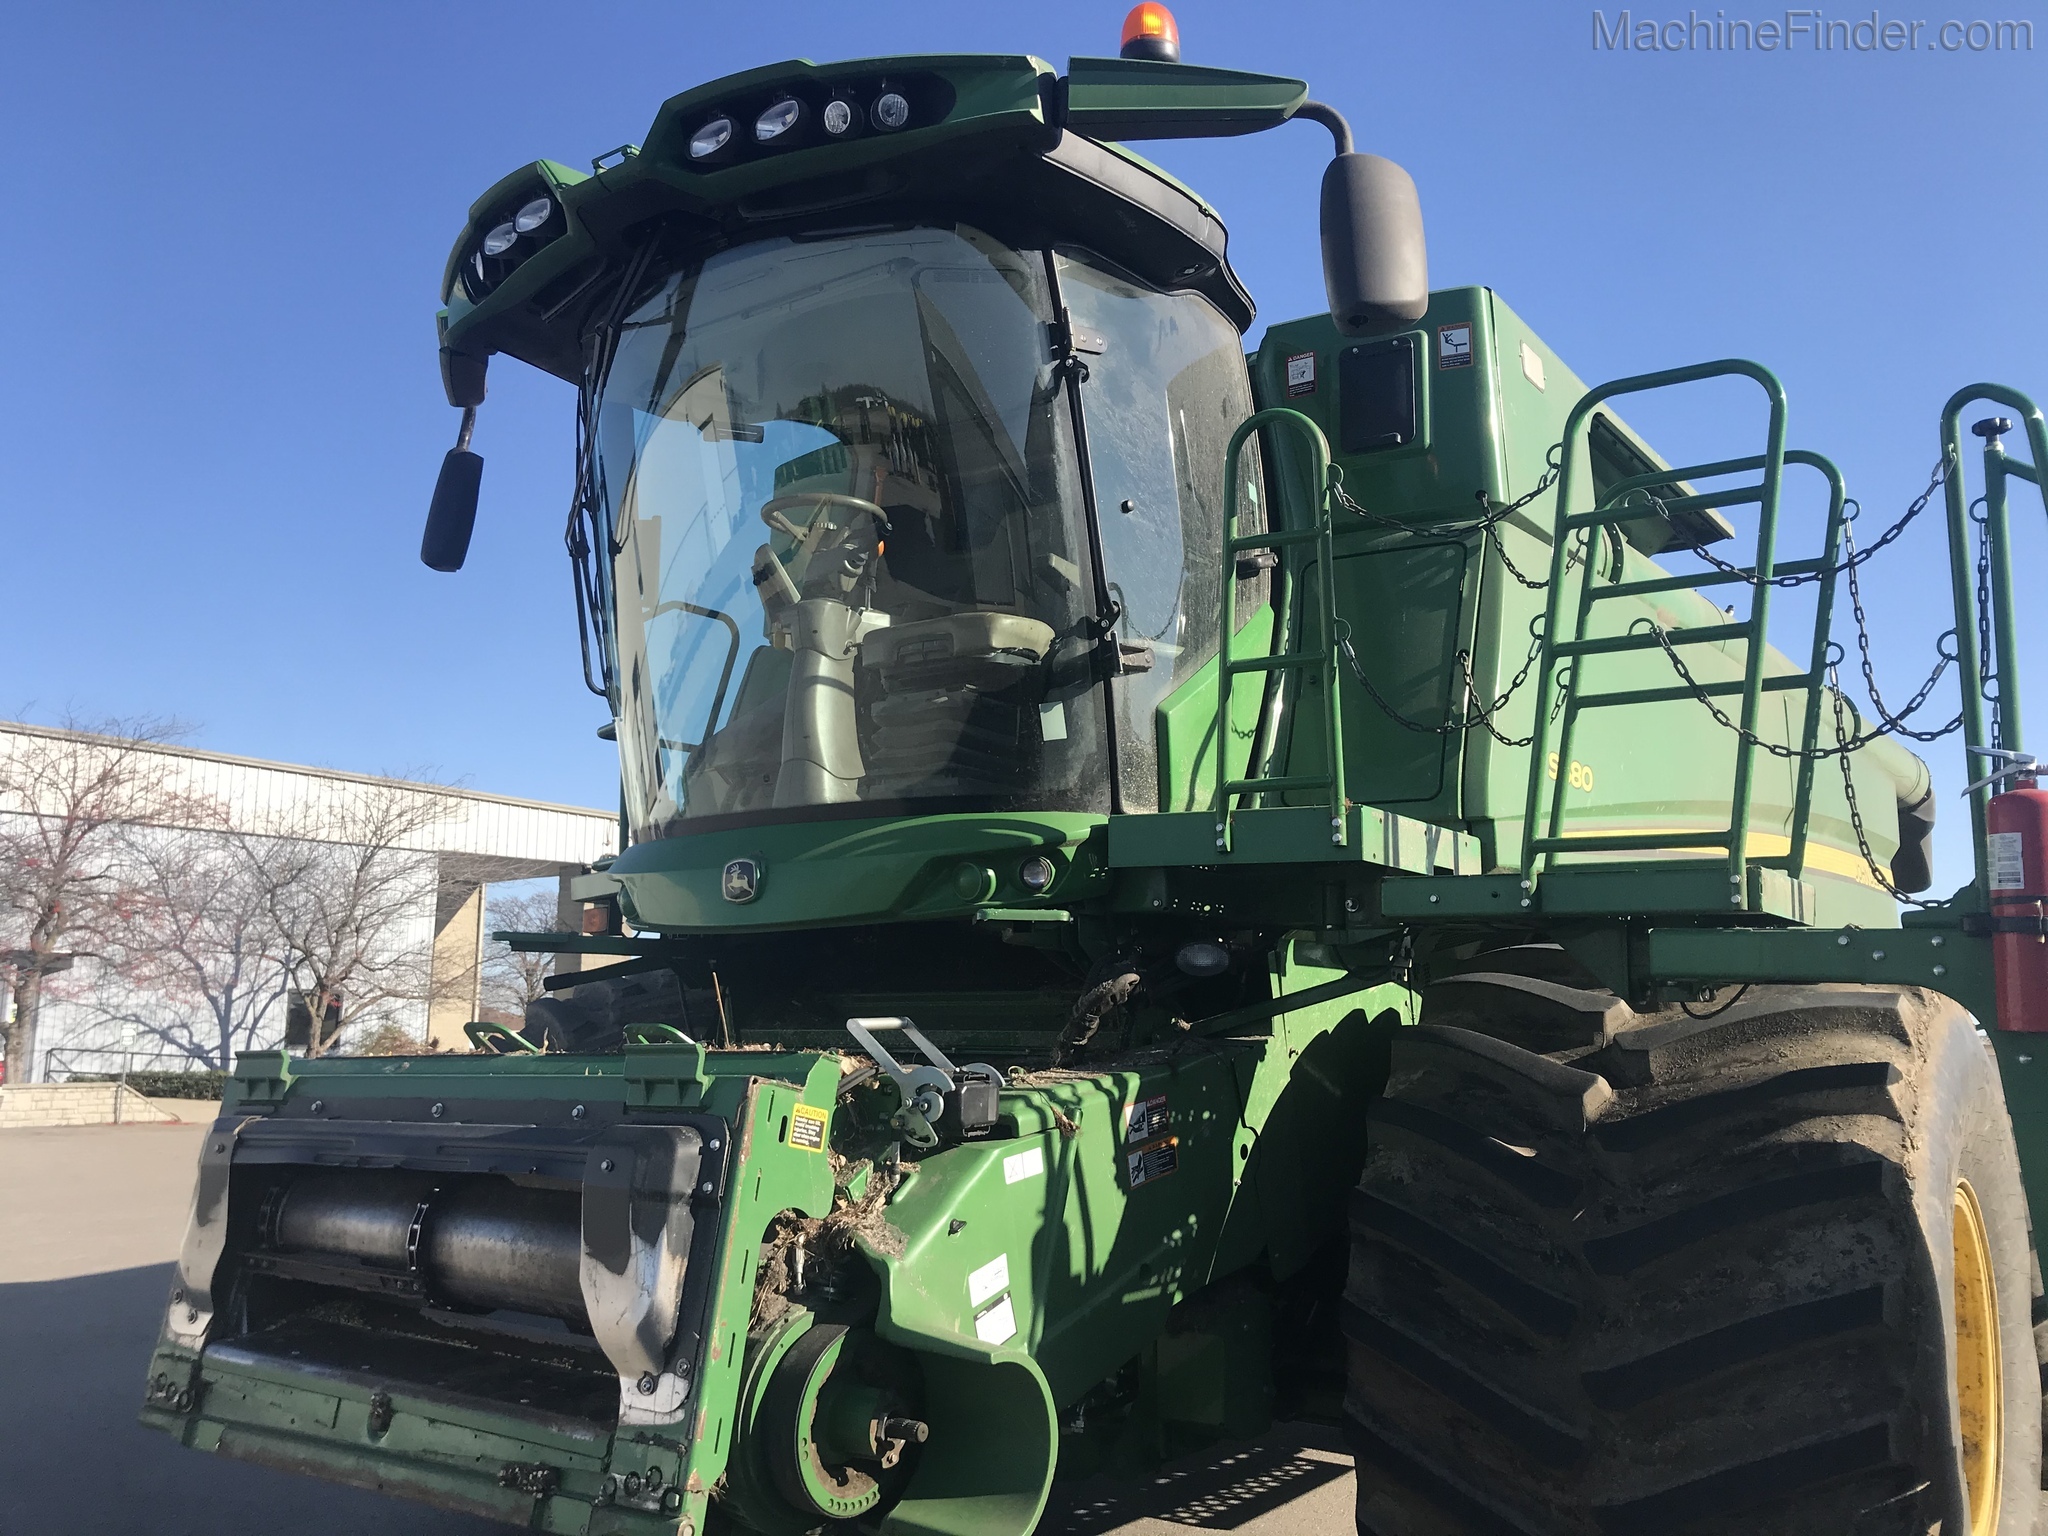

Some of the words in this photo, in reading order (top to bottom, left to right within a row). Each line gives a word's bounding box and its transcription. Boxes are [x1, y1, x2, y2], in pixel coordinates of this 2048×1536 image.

[1293, 351, 1314, 360] DANGER
[1548, 751, 1594, 793] S80
[800, 1106, 827, 1119] CAUTION
